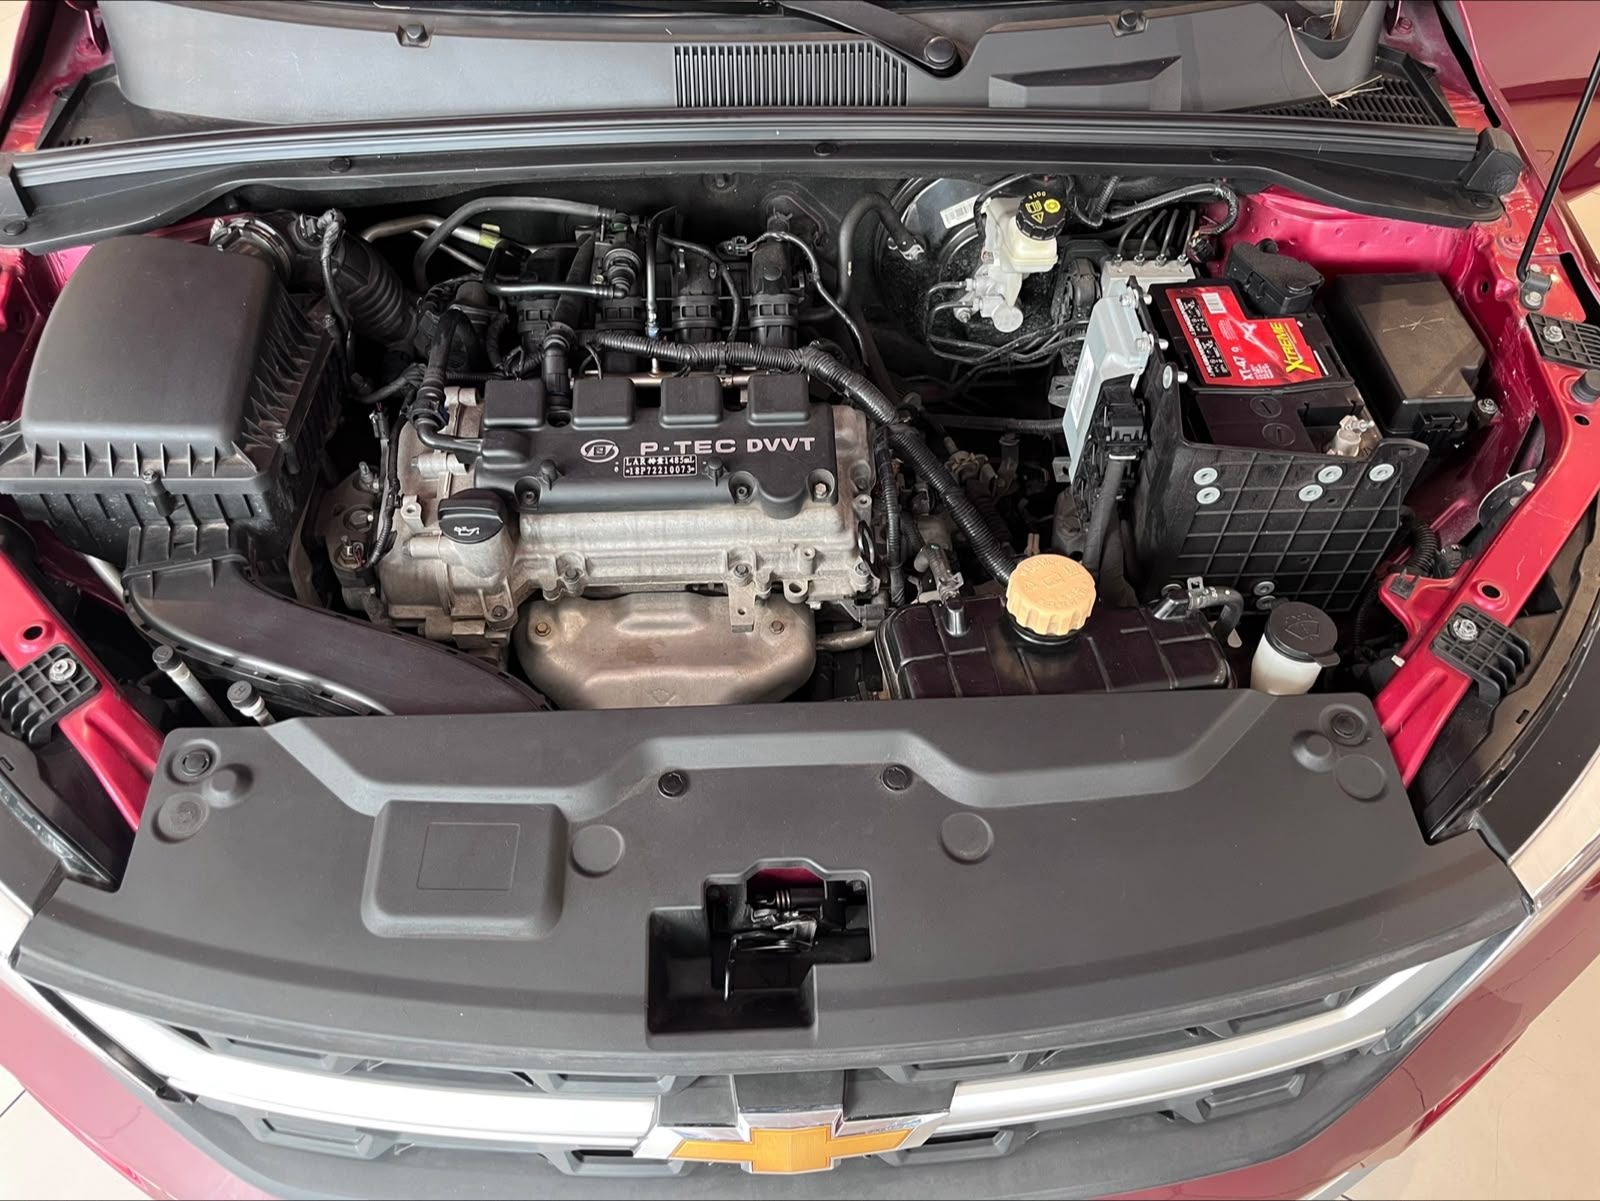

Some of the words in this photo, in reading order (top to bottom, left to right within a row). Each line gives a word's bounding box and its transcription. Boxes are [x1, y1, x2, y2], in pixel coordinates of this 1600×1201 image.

[1270, 322, 1314, 374] XTREME
[640, 439, 736, 455] P-TEC
[747, 437, 816, 453] DVVT
